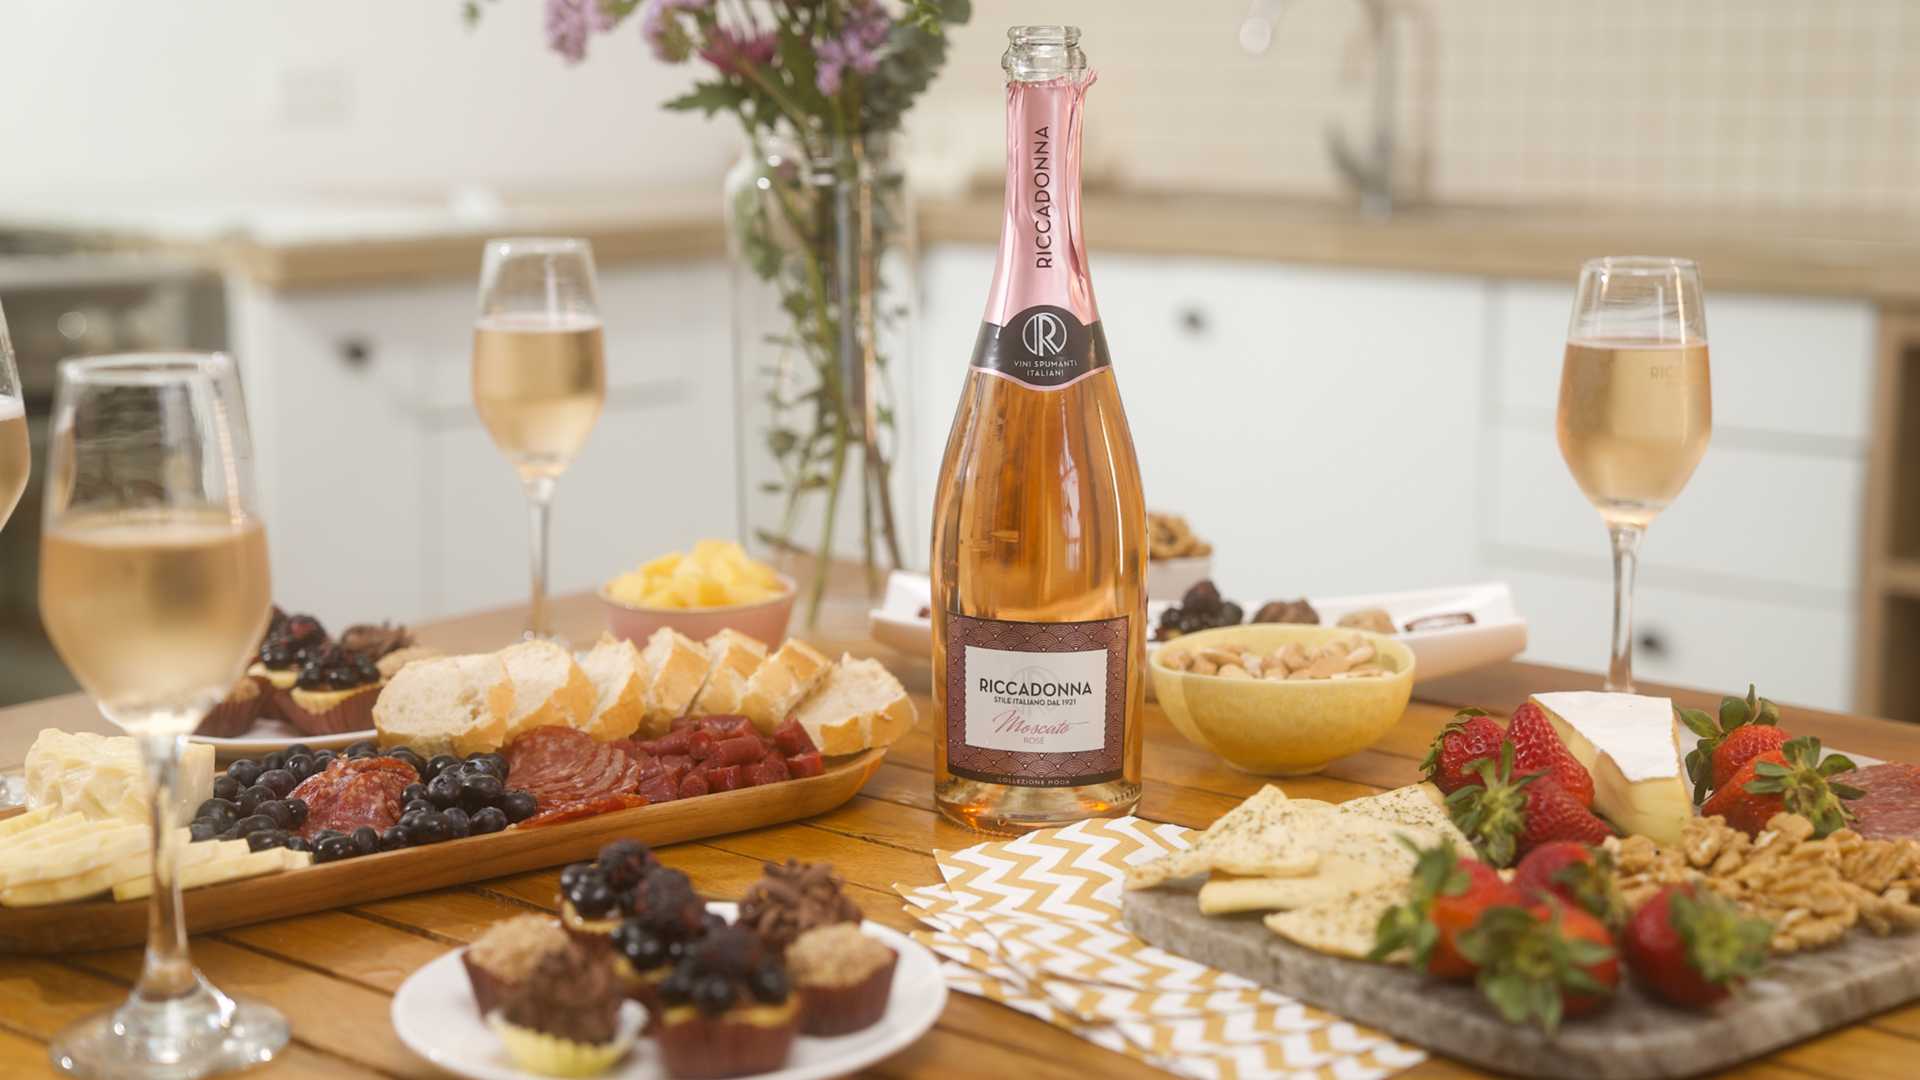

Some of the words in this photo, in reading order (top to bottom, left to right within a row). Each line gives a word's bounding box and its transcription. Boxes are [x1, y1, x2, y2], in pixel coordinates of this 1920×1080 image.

[1033, 126, 1053, 269] RICCADONNA
[1014, 360, 1032, 368] VINI
[1033, 360, 1077, 368] SPUMANTI
[1026, 369, 1064, 377] ITALIANI
[979, 677, 1093, 697] RICCADONNA
[993, 696, 1012, 705] STILE
[1012, 698, 1046, 706] ITALIANO
[1062, 698, 1077, 706] 1921
[992, 709, 1089, 735] Moscato
